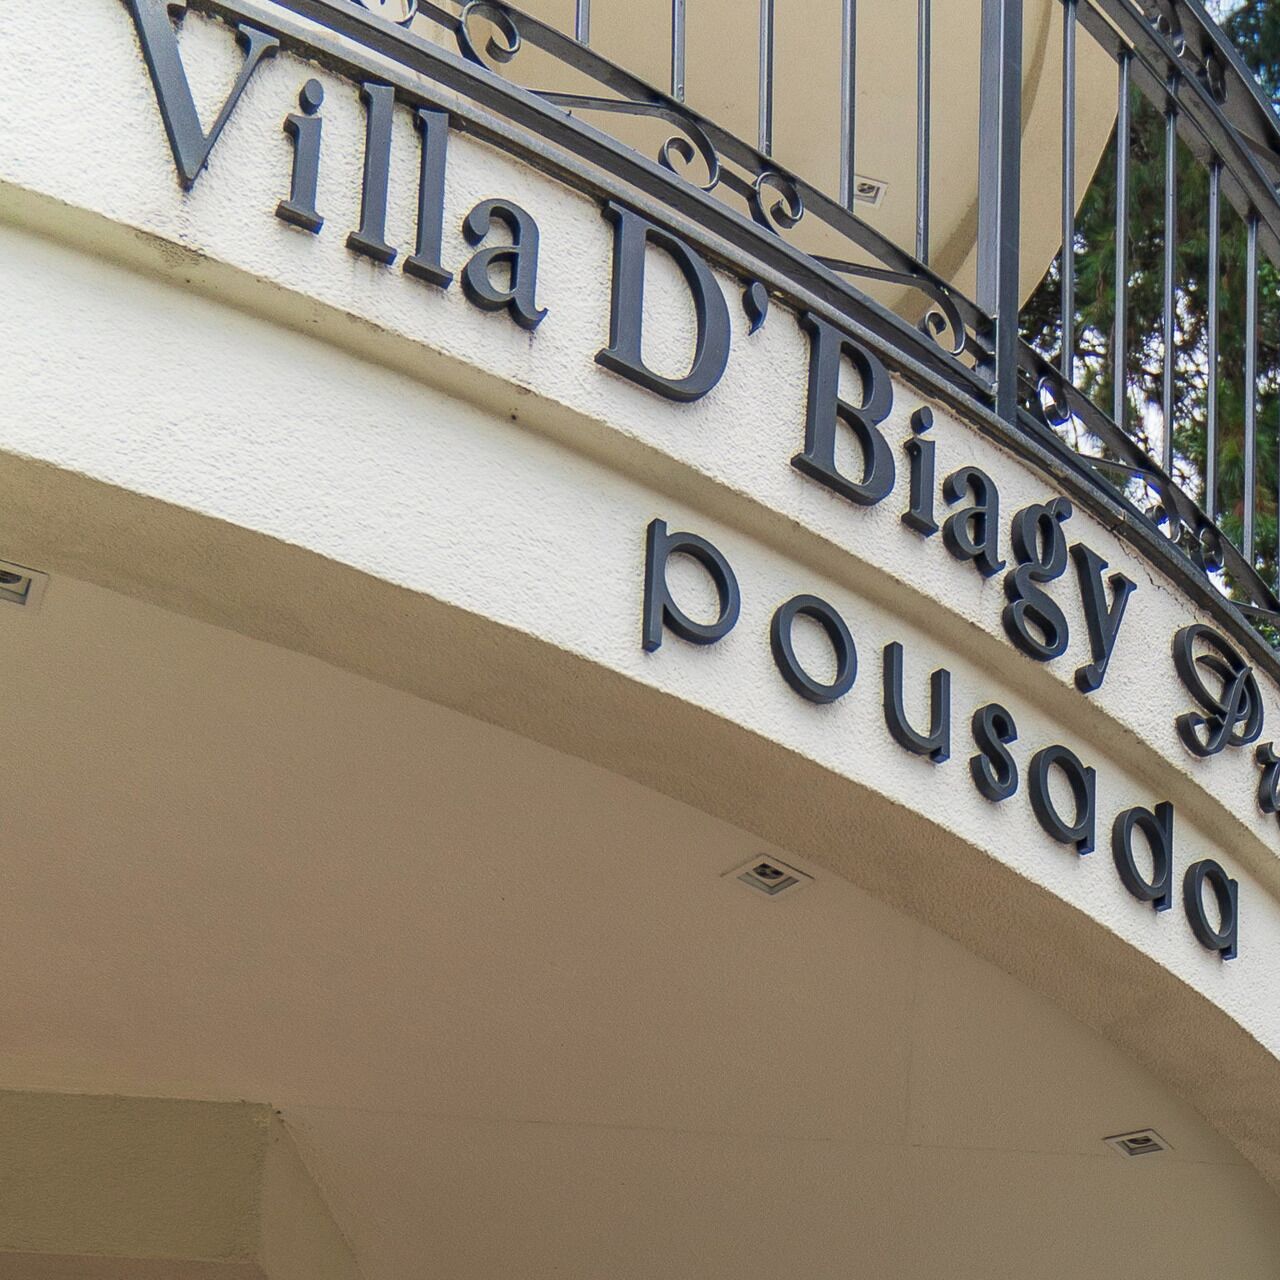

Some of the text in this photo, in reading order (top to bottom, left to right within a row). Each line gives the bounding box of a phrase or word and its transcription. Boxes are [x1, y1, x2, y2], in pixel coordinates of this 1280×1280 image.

[120, 0, 548, 330] Villa
[593, 199, 1137, 694] D'Biagy
[641, 518, 1239, 960] pousada
